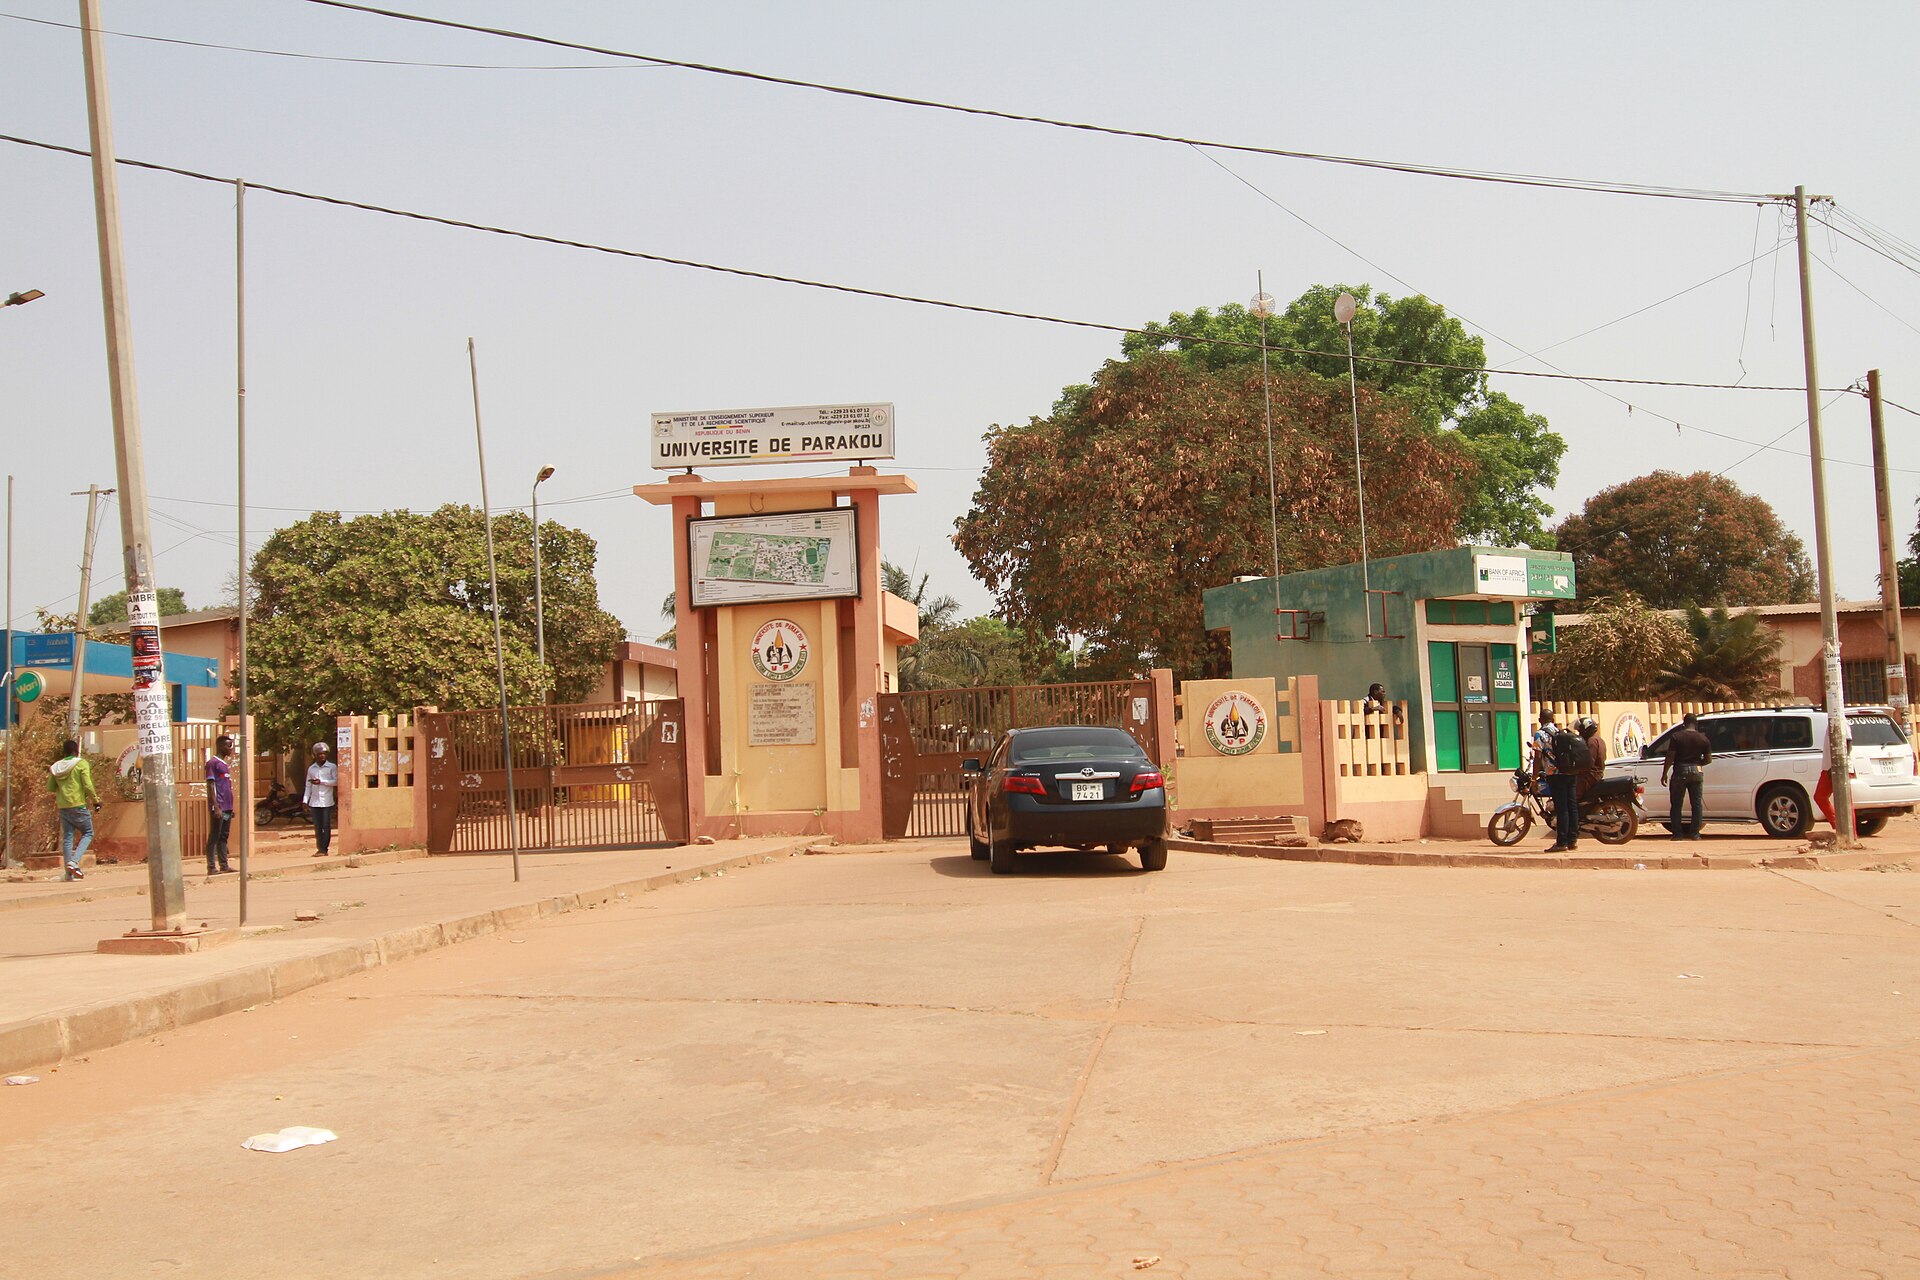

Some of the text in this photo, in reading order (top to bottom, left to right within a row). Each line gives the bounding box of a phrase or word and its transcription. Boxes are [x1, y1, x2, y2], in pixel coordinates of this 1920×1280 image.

[660, 434, 882, 457] UNIVERSITE DE PARAKOU
[16, 678, 38, 695] Wari
[1208, 696, 1228, 718] UNIVERSITE
[1240, 695, 1261, 714] PARAKOU
[1856, 716, 1884, 724] TOYOTA
